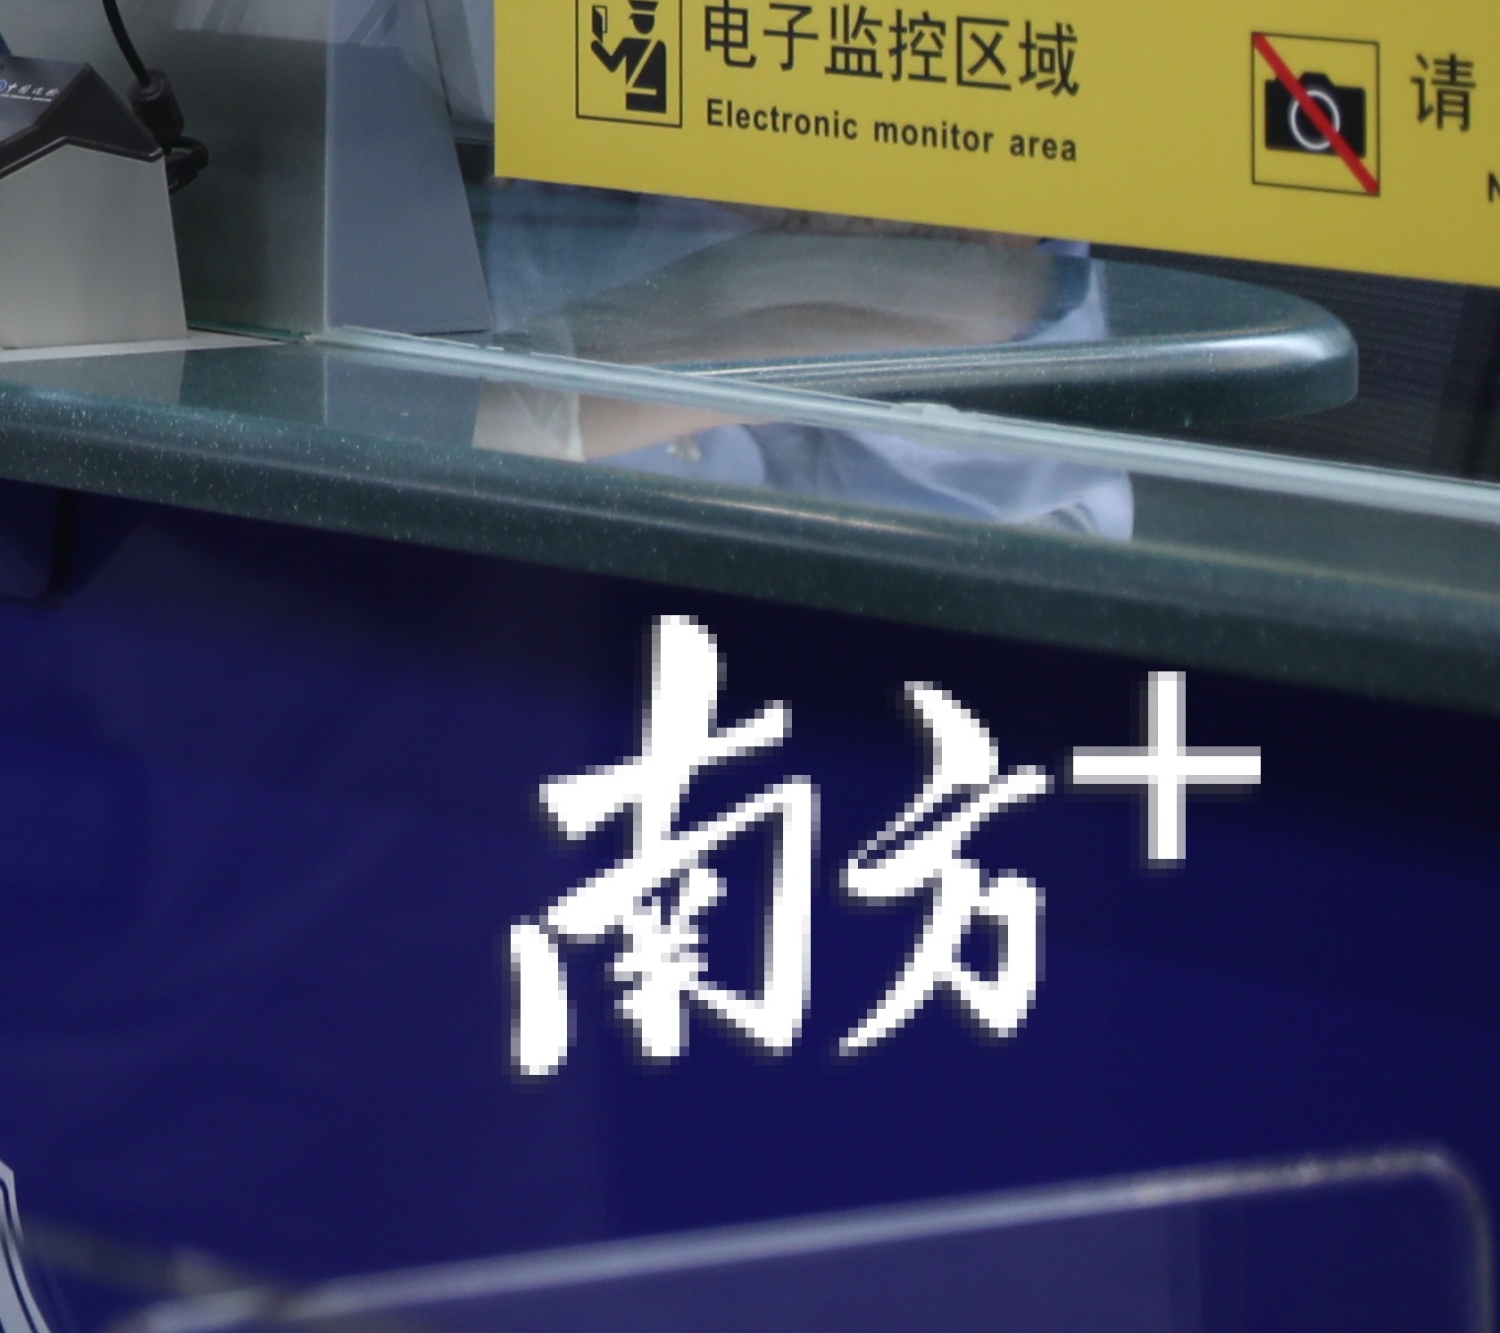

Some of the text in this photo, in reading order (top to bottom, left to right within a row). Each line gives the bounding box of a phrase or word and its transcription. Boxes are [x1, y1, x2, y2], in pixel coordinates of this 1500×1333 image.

[1410, 52, 1477, 133] 请
[706, 98, 1078, 164] Electronic monitor area
